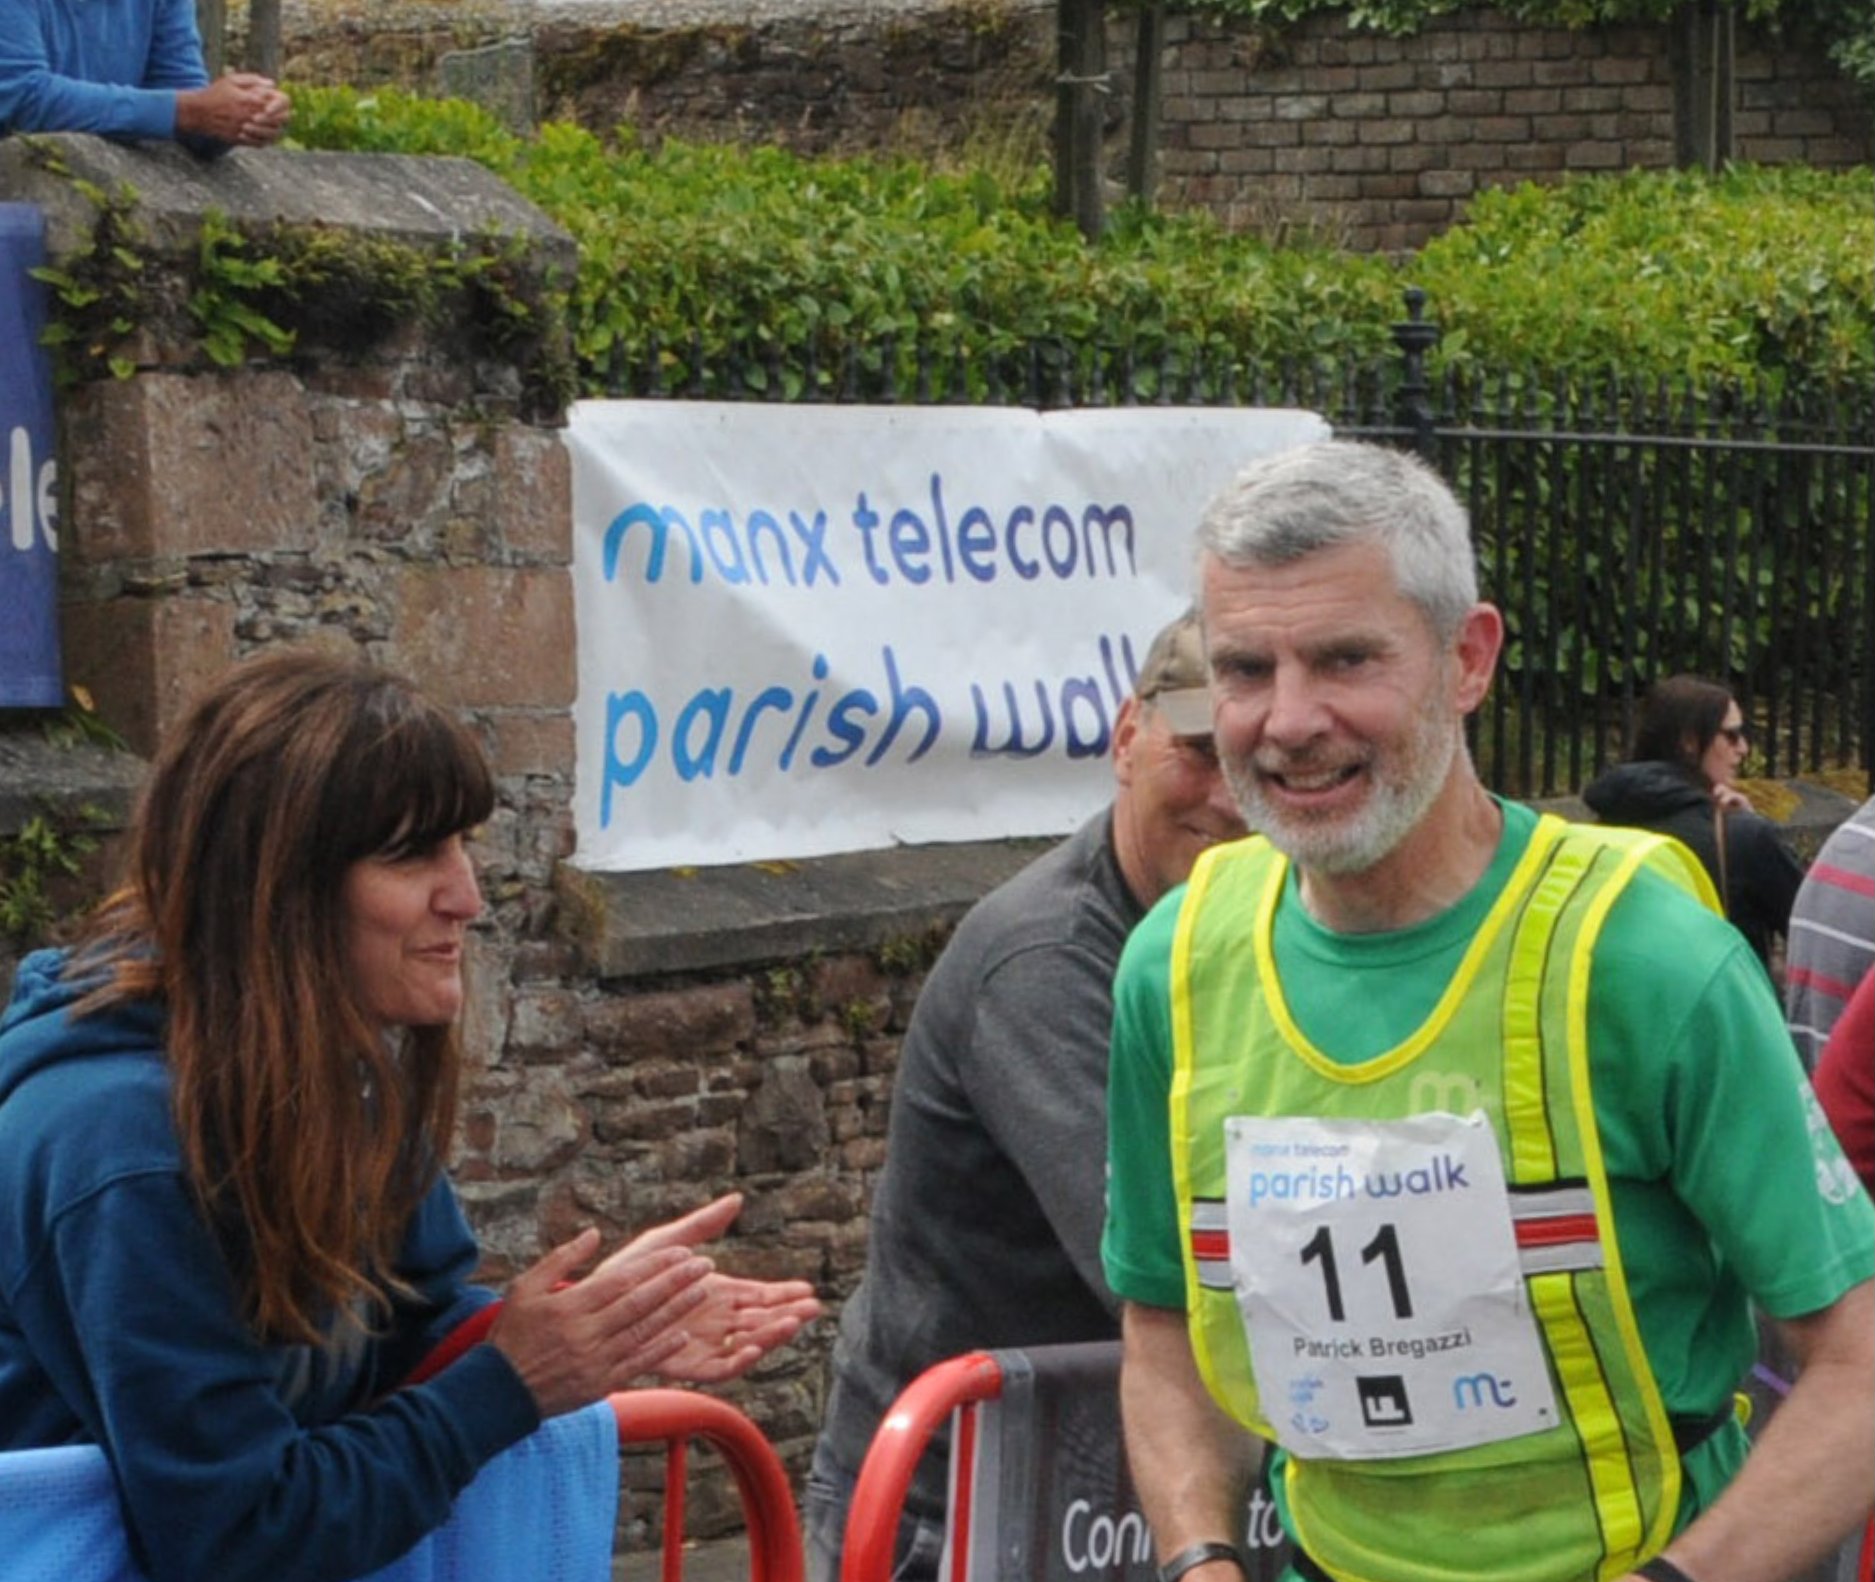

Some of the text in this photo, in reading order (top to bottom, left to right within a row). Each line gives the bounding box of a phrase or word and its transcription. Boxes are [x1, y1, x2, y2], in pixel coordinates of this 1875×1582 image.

[603, 473, 1138, 587] manx telecom
[600, 645, 942, 829] parish
[1250, 1153, 1470, 1208] parish walk
[1301, 1223, 1414, 1322] 11
[1294, 1328, 1473, 1360] Patrick Bregazzi
